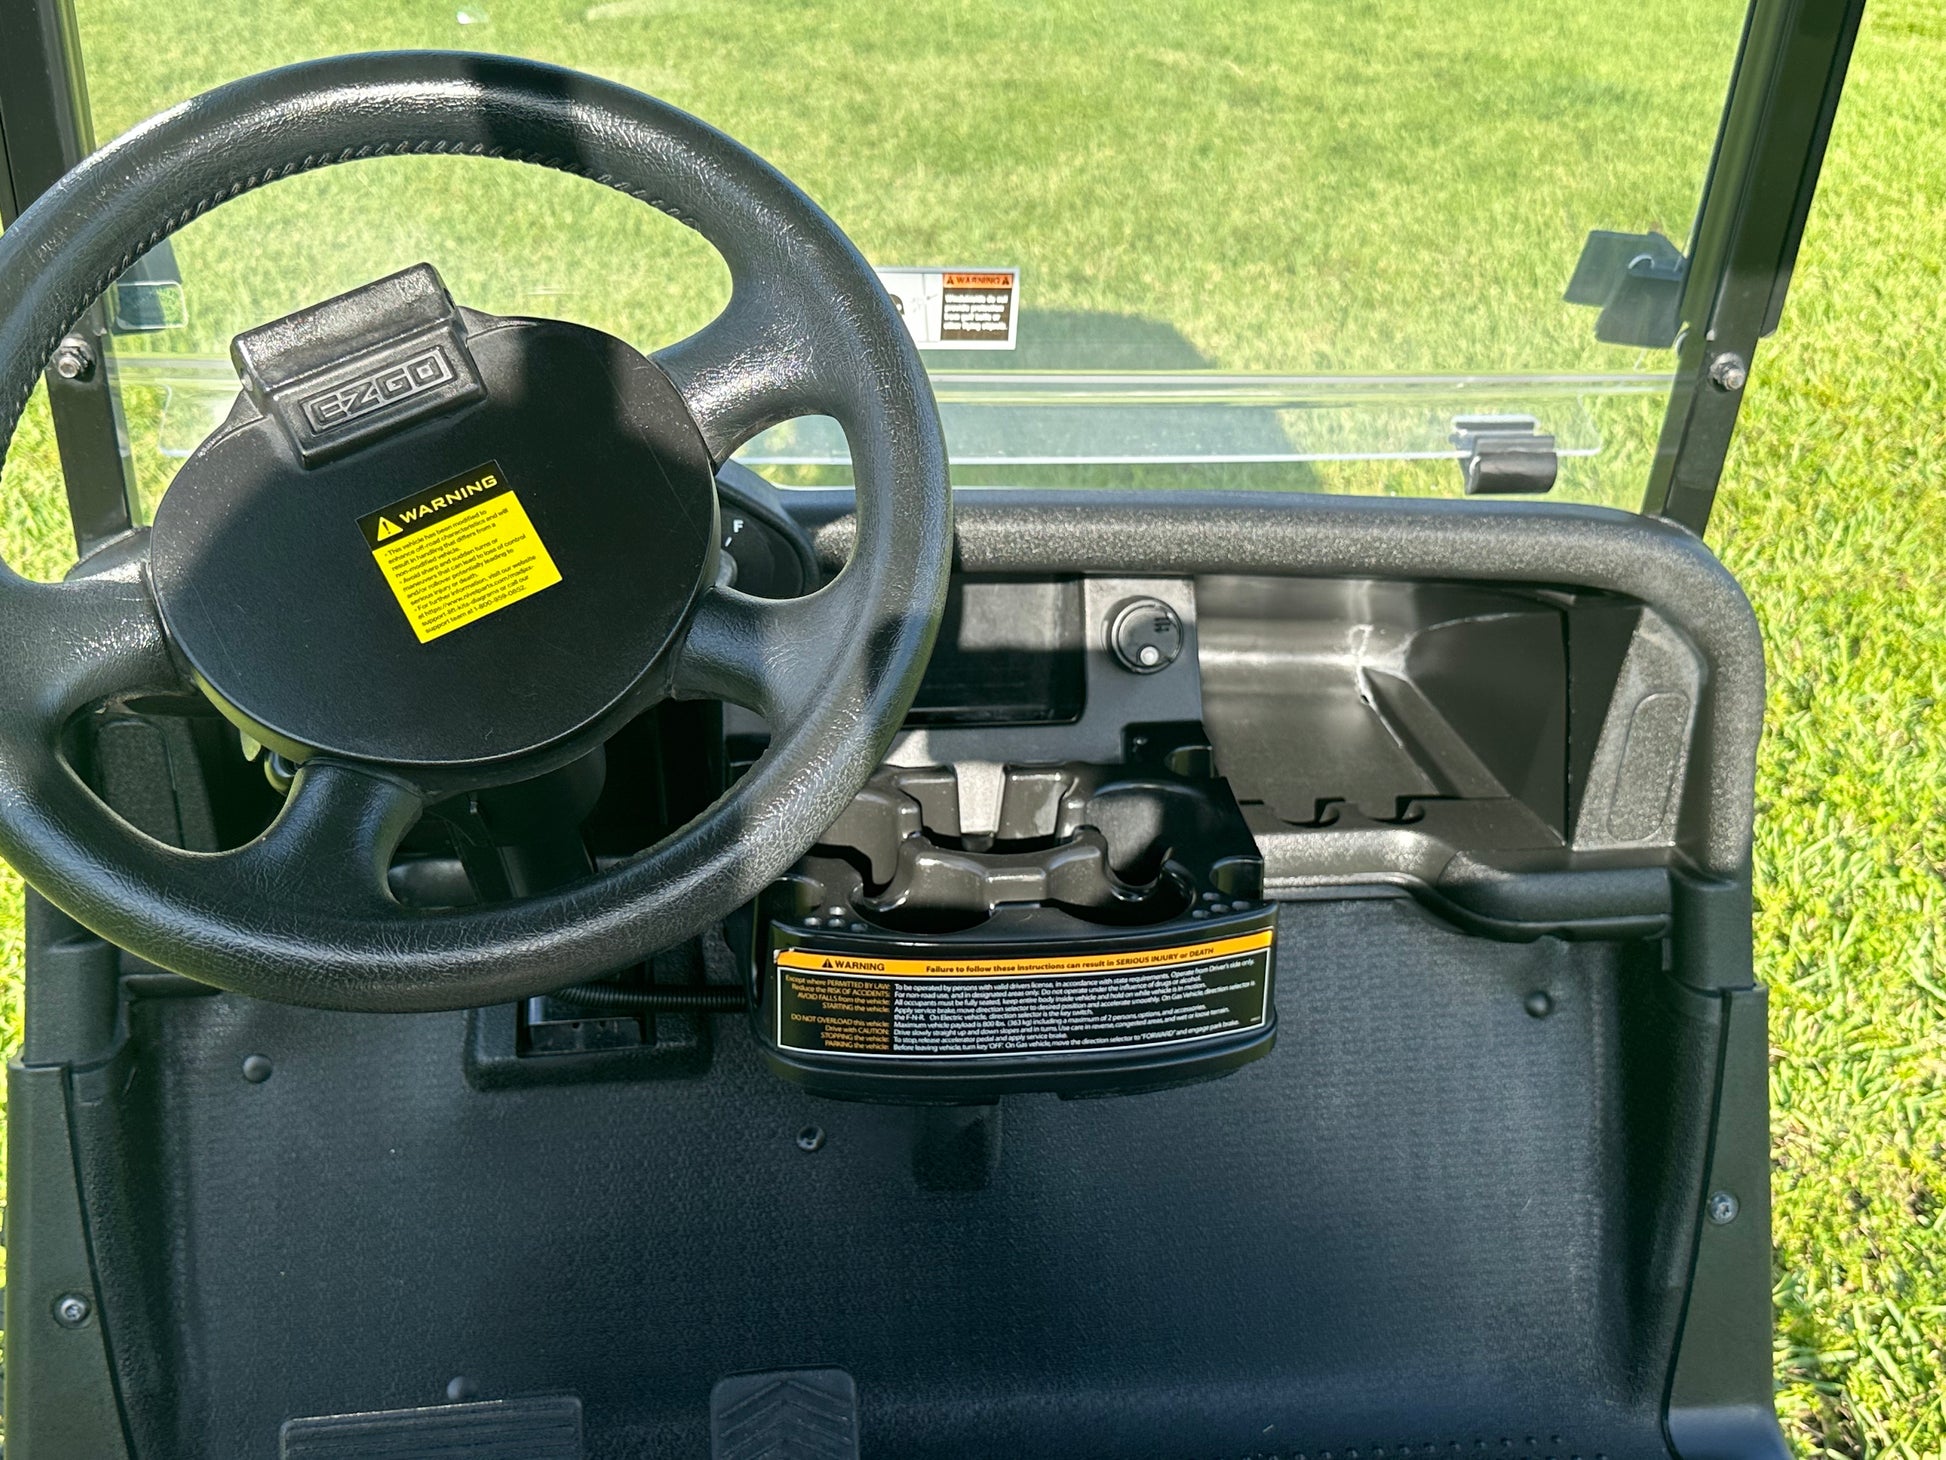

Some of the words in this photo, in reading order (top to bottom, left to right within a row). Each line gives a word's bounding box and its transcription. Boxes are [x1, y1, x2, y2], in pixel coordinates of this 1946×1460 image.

[399, 475, 498, 524] WARNING
[387, 546, 402, 555] This
[402, 536, 424, 548] vehicle
[436, 524, 452, 534] been
[452, 513, 479, 527] modified
[387, 549, 415, 563] enhance
[415, 538, 440, 551] off-road
[440, 518, 485, 540] characteristics
[391, 560, 409, 570] result
[416, 545, 444, 561] handling
[443, 540, 456, 548] that
[456, 531, 476, 542] differs
[476, 524, 491, 533] from
[733, 520, 743, 533] F
[395, 556, 437, 577] non-modified
[402, 572, 420, 582] Avoid
[420, 564, 439, 576] sharp
[438, 558, 451, 566] and
[451, 548, 474, 561] sudden
[474, 541, 491, 551] turns
[403, 574, 437, 591] maneuvers
[437, 567, 450, 576] that
[462, 556, 476, 564] lead
[483, 547, 496, 555] loss
[504, 534, 526, 546] control
[406, 586, 427, 598] and/or
[427, 575, 451, 588] rollover
[451, 561, 484, 579] potentially
[483, 551, 507, 565] leading
[428, 593, 450, 605] further
[488, 570, 500, 579] visit
[511, 554, 536, 568] website
[410, 593, 433, 605] serious
[433, 585, 451, 596] injury
[425, 619, 451, 634] support
[450, 611, 466, 621] team
[834, 960, 884, 971] WARNING
[1017, 962, 1064, 971] instructions
[1082, 960, 1104, 968] result
[1116, 956, 1148, 965] SERIOUS
[1151, 952, 1178, 962] INJURY
[1189, 947, 1213, 957] DEATH
